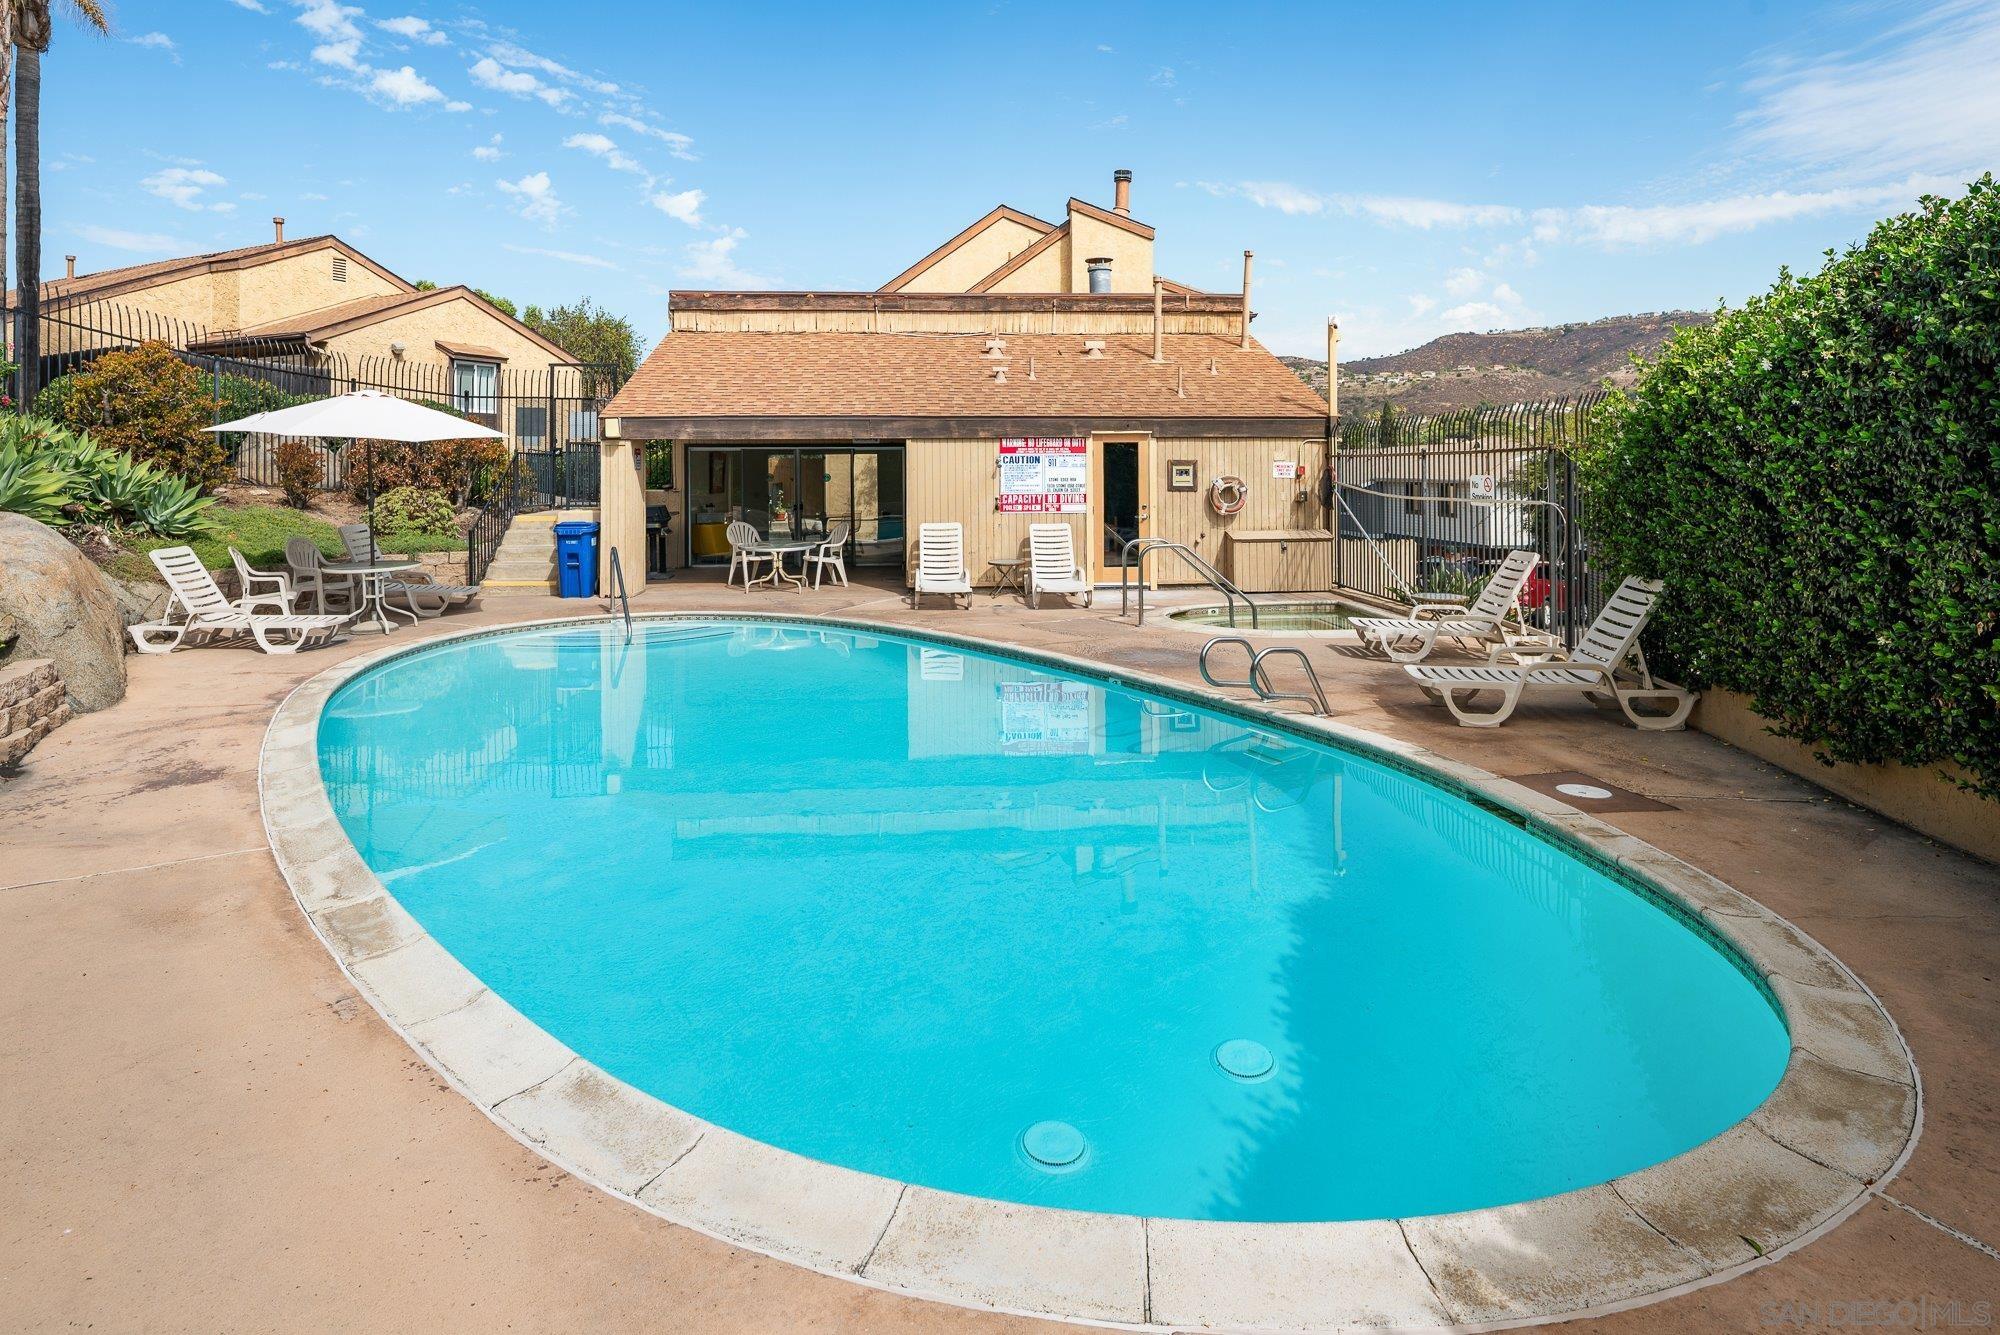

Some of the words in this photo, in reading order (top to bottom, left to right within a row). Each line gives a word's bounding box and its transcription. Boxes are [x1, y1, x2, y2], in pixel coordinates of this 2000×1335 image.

[1001, 438, 1027, 448] WARNING:
[1028, 438, 1035, 448] NO
[1036, 438, 1063, 448] LIFEGUARD
[1063, 438, 1071, 448] ON
[1072, 438, 1085, 448] DUTY
[1003, 455, 1041, 465] CAUTION
[1048, 458, 1057, 467] 911
[1472, 481, 1479, 489] No
[1002, 494, 1042, 504] CAPACITY
[1047, 494, 1058, 503] NO
[1061, 494, 1085, 503] DIVING
